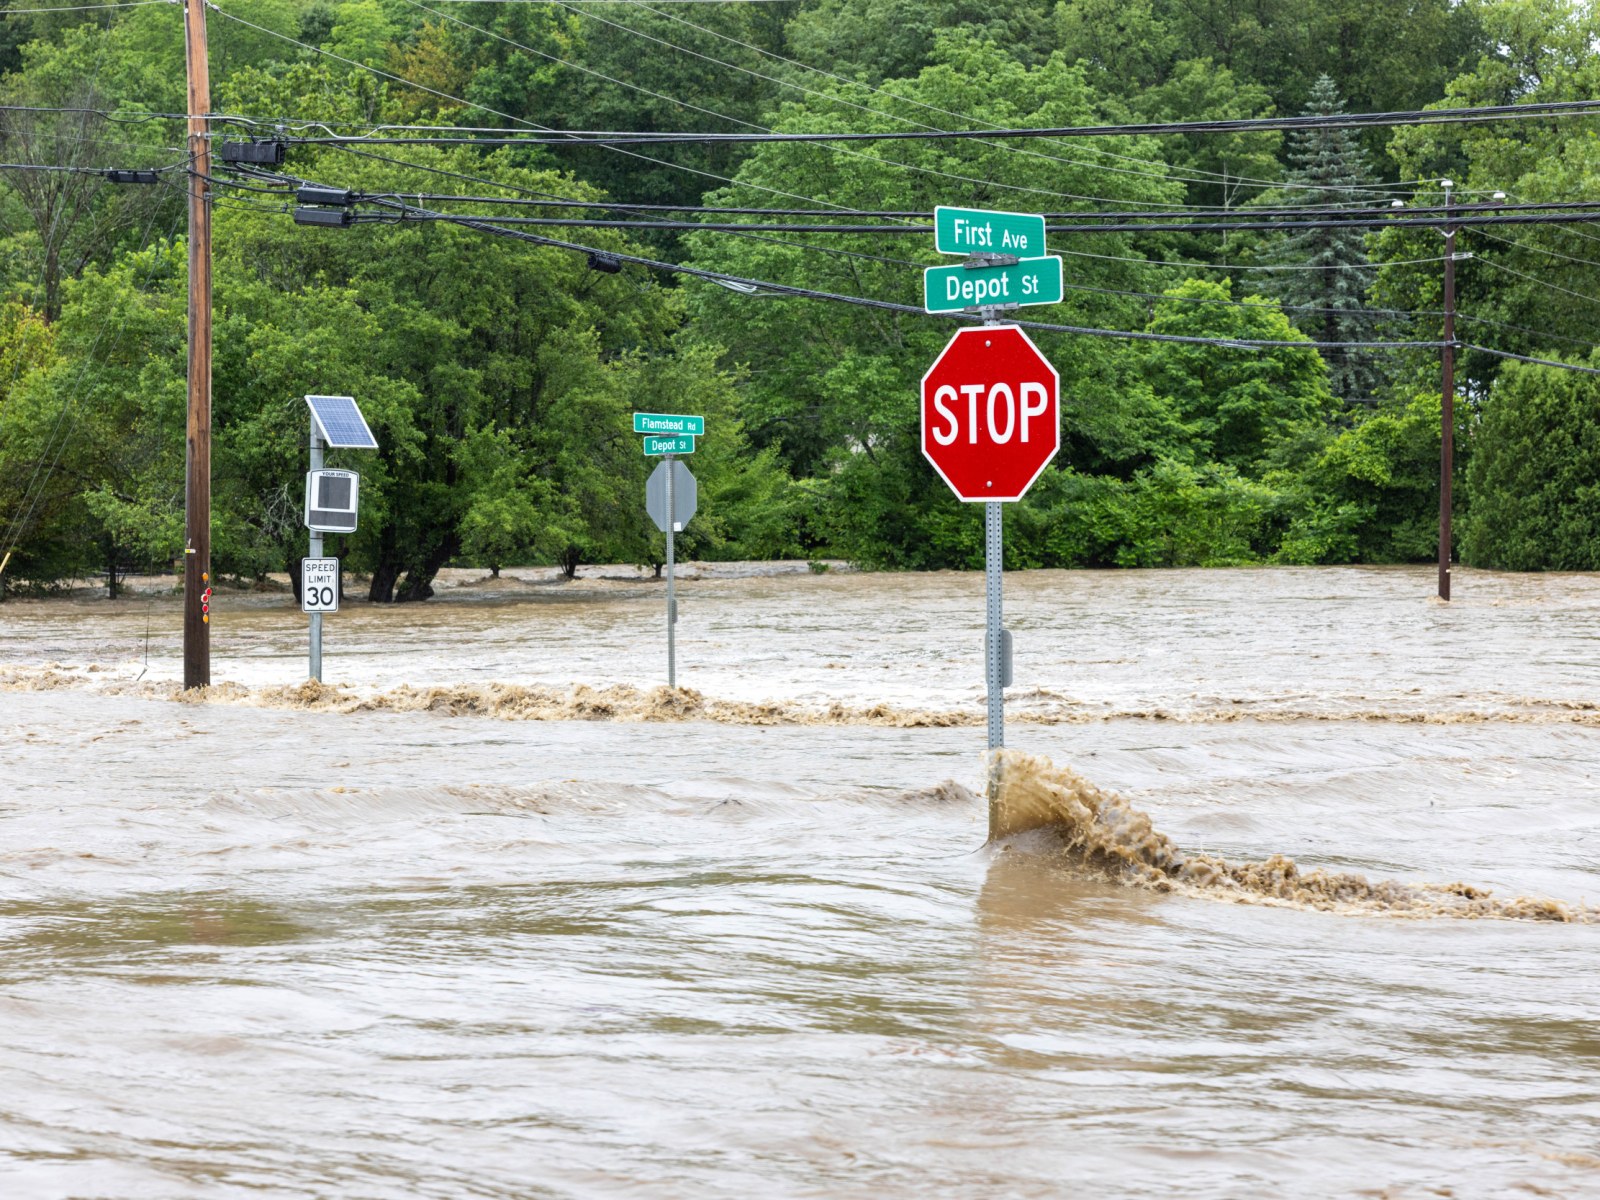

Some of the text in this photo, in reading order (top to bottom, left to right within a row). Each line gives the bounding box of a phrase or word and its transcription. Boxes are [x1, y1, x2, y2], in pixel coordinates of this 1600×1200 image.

[954, 219, 1028, 249] First Ave
[946, 271, 1039, 304] Depot St
[932, 382, 1048, 446] STOP
[642, 418, 696, 431] Flamstead Rd
[652, 440, 686, 452] Depot St
[306, 563, 335, 572] SPEED
[309, 575, 331, 583] LIMIT
[306, 586, 334, 606] 30
